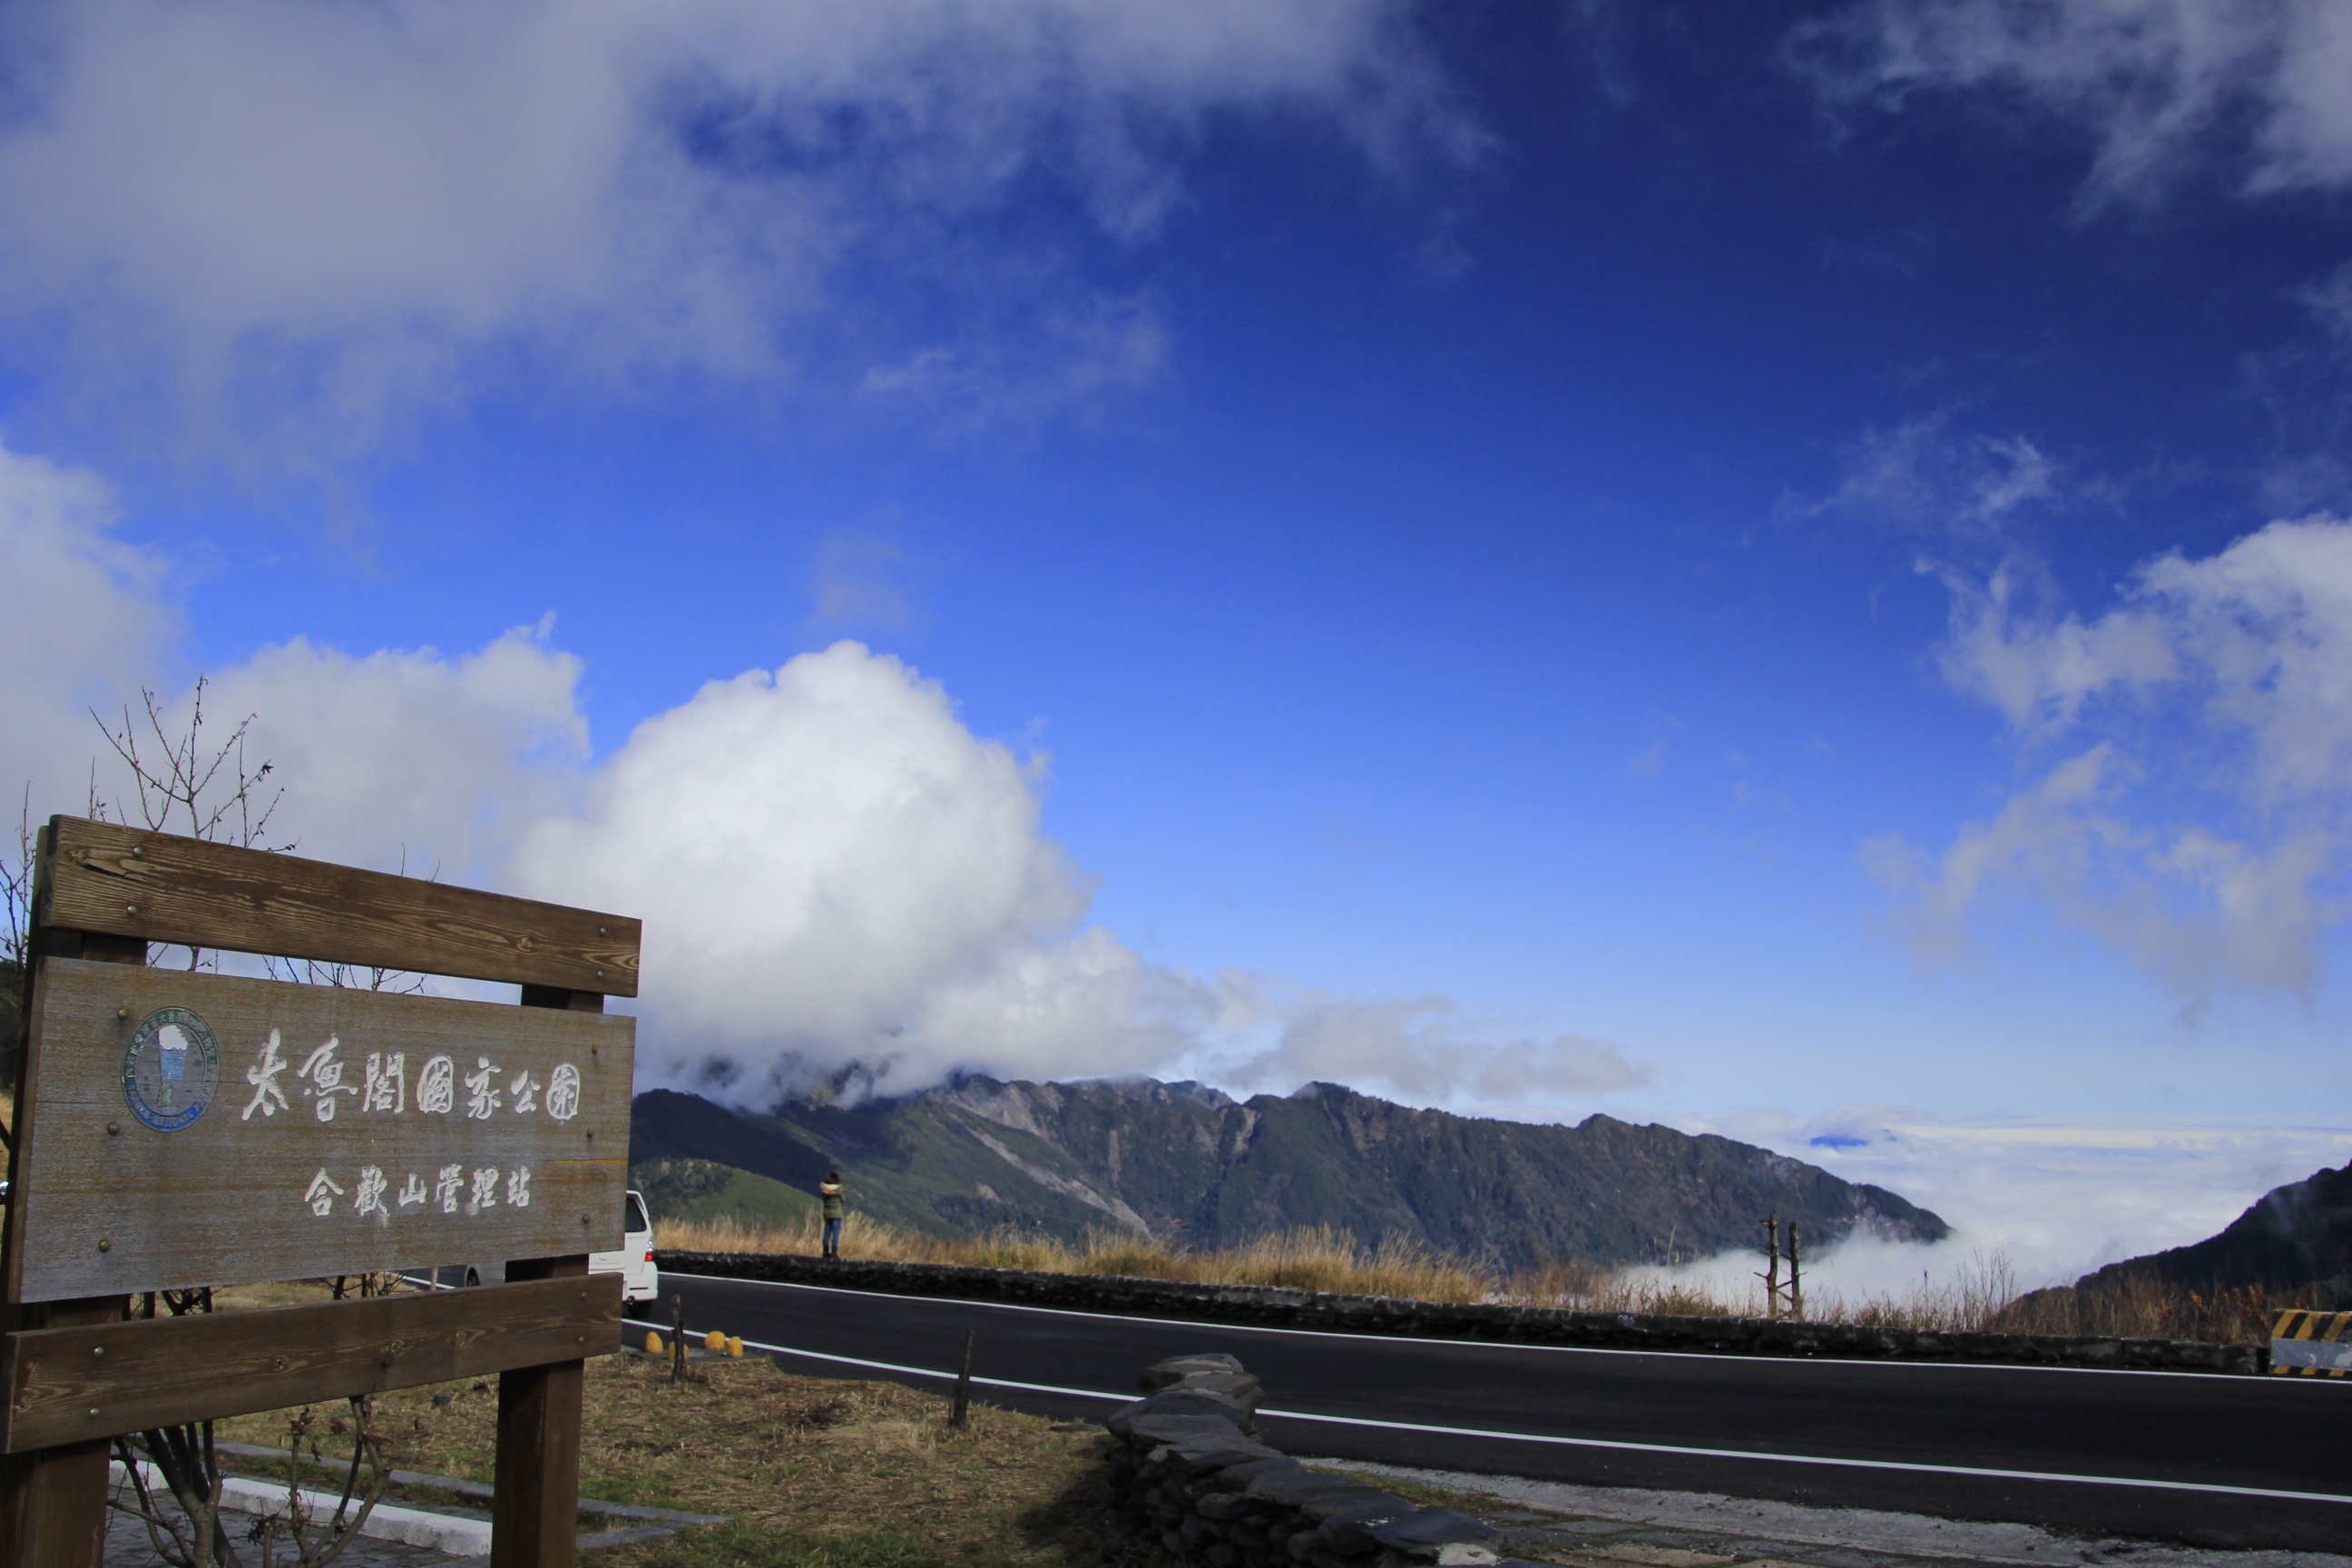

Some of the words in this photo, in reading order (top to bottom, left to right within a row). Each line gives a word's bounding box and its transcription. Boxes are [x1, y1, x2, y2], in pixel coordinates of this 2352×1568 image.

[241, 1027, 581, 1122] 太魯閣國家公園
[305, 1163, 531, 1217] 合歡山管理站
